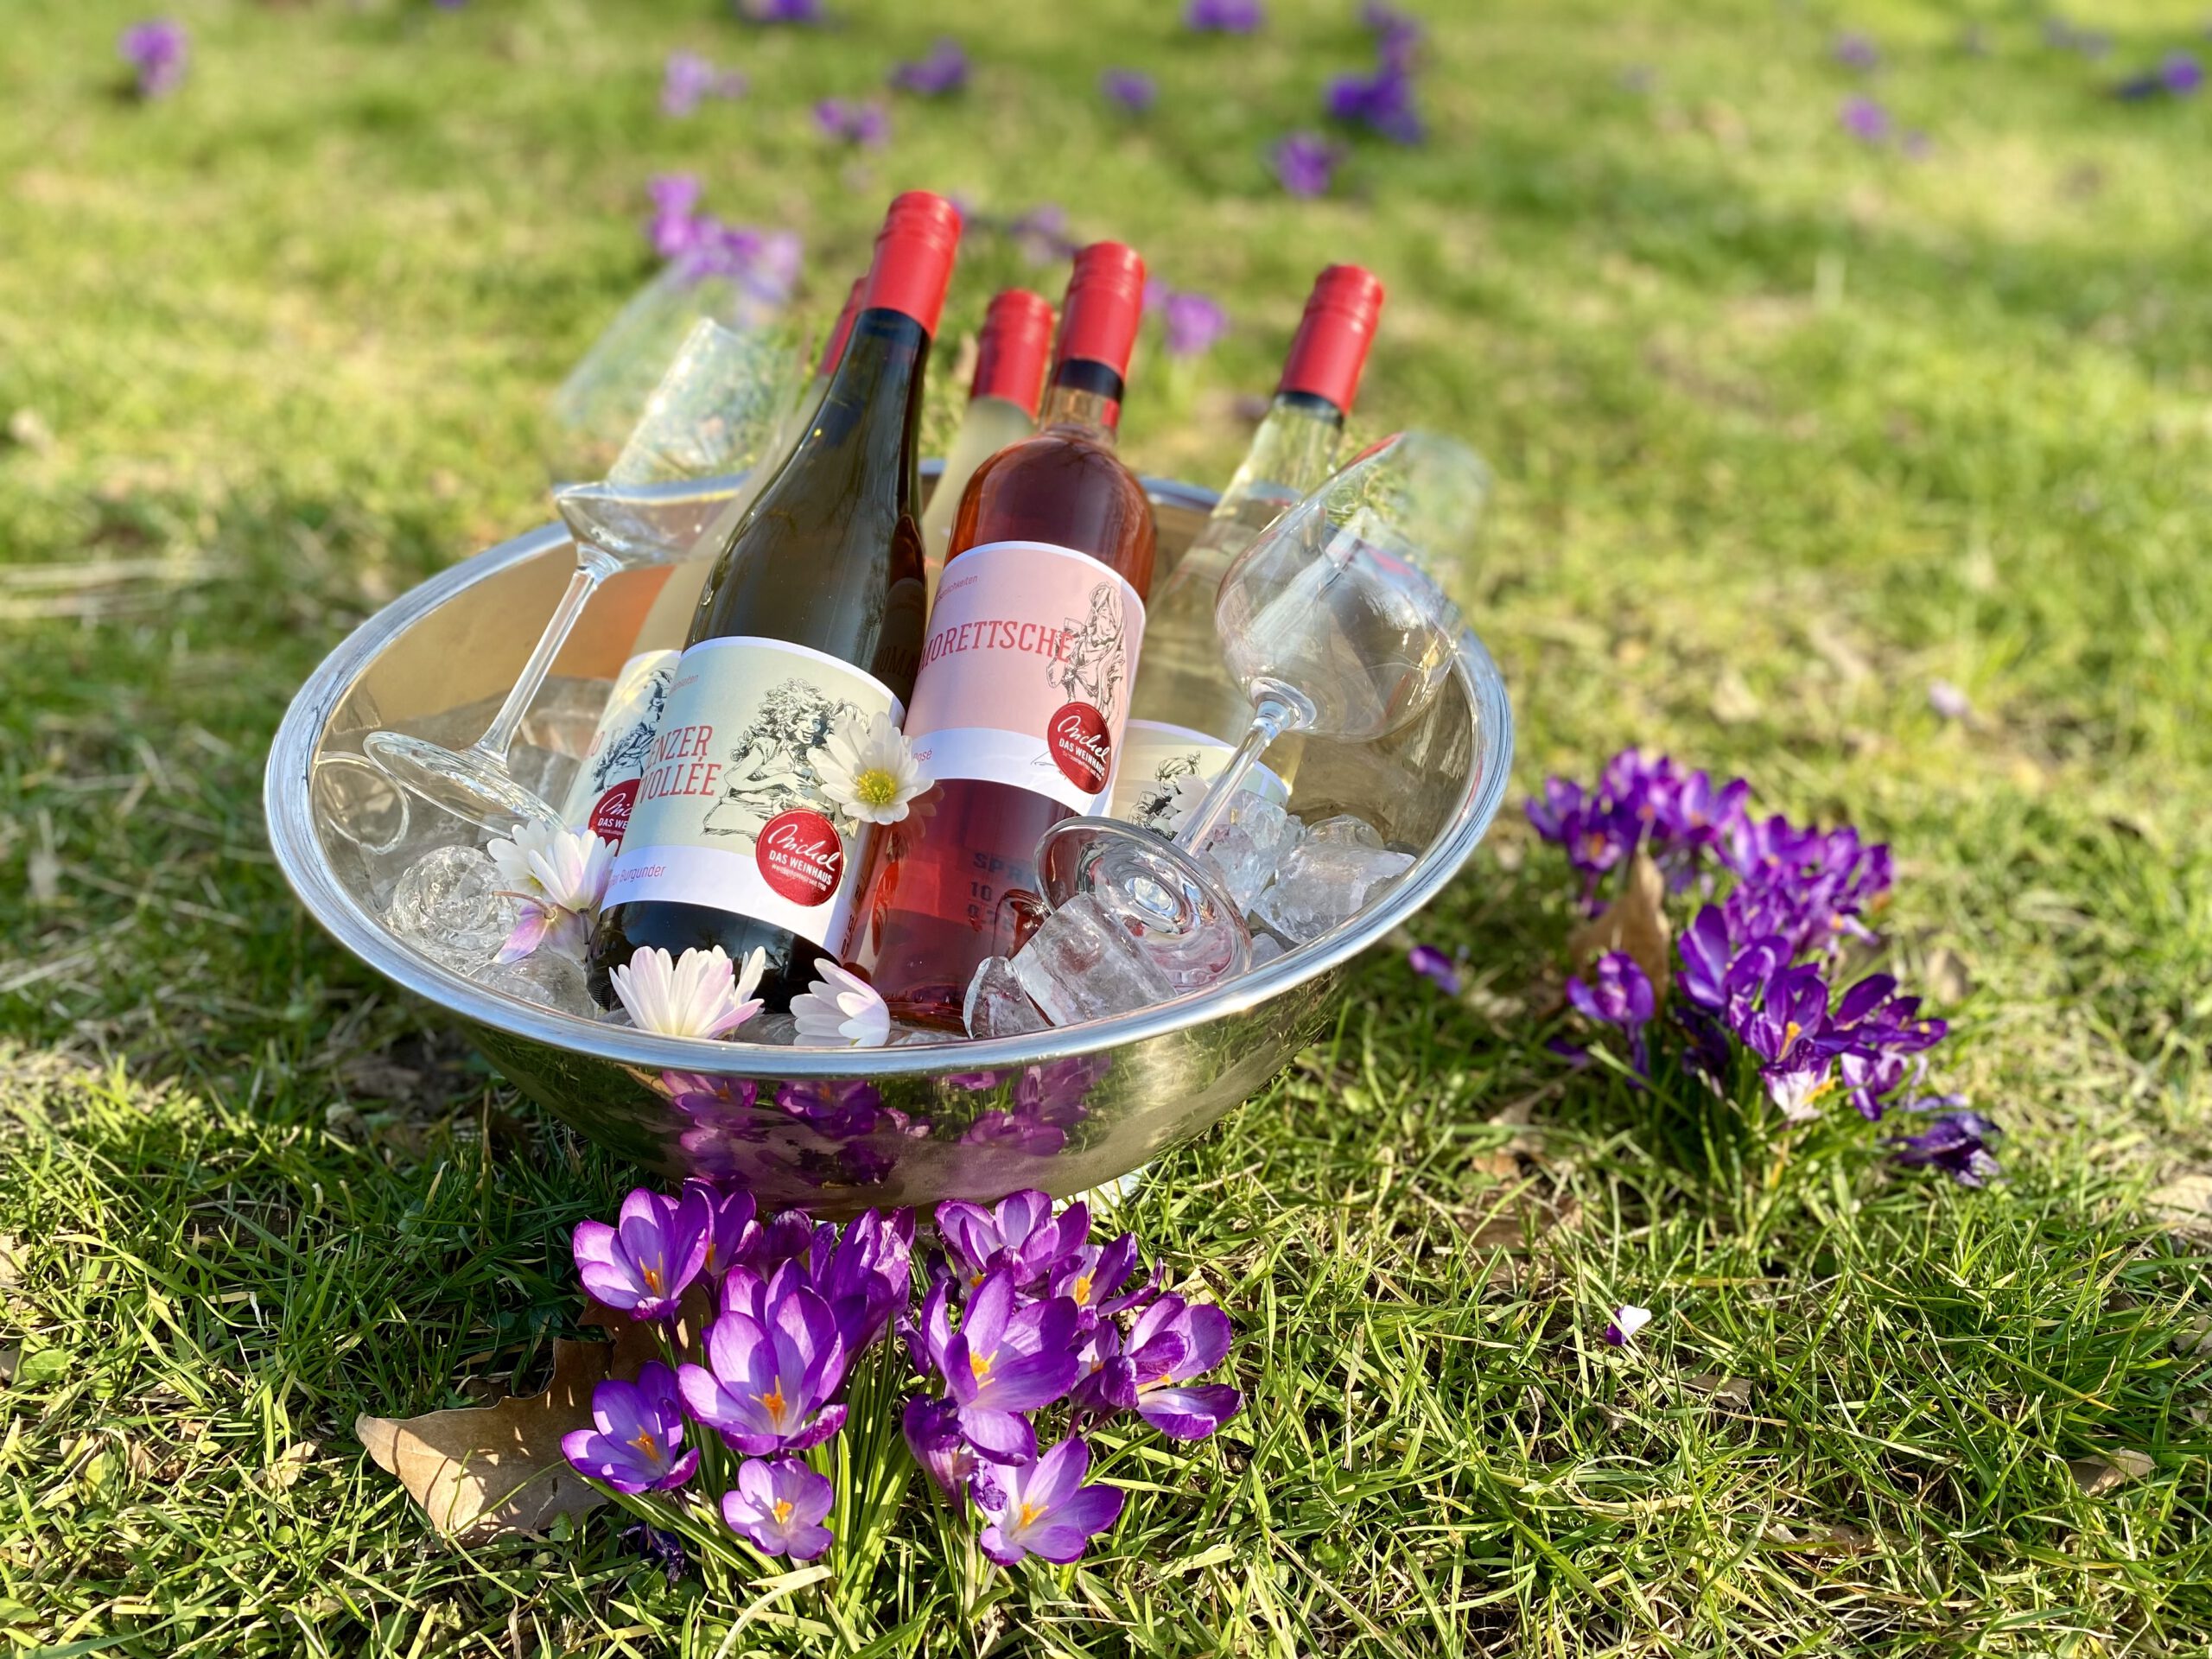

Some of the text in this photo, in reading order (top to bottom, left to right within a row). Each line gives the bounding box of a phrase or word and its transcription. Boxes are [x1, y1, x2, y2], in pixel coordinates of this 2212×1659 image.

[918, 620, 1074, 675] MORETTSCHE
[1058, 715, 1110, 764] Michel
[1059, 738, 1075, 753] DAS
[1075, 746, 1105, 777] WEINHAUS
[640, 756, 721, 804] VOLLÉE
[598, 817, 613, 827] DAS
[768, 823, 841, 872] Michel
[769, 849, 832, 886] DAS WEINHAUS
[620, 864, 667, 882] Burgunder
